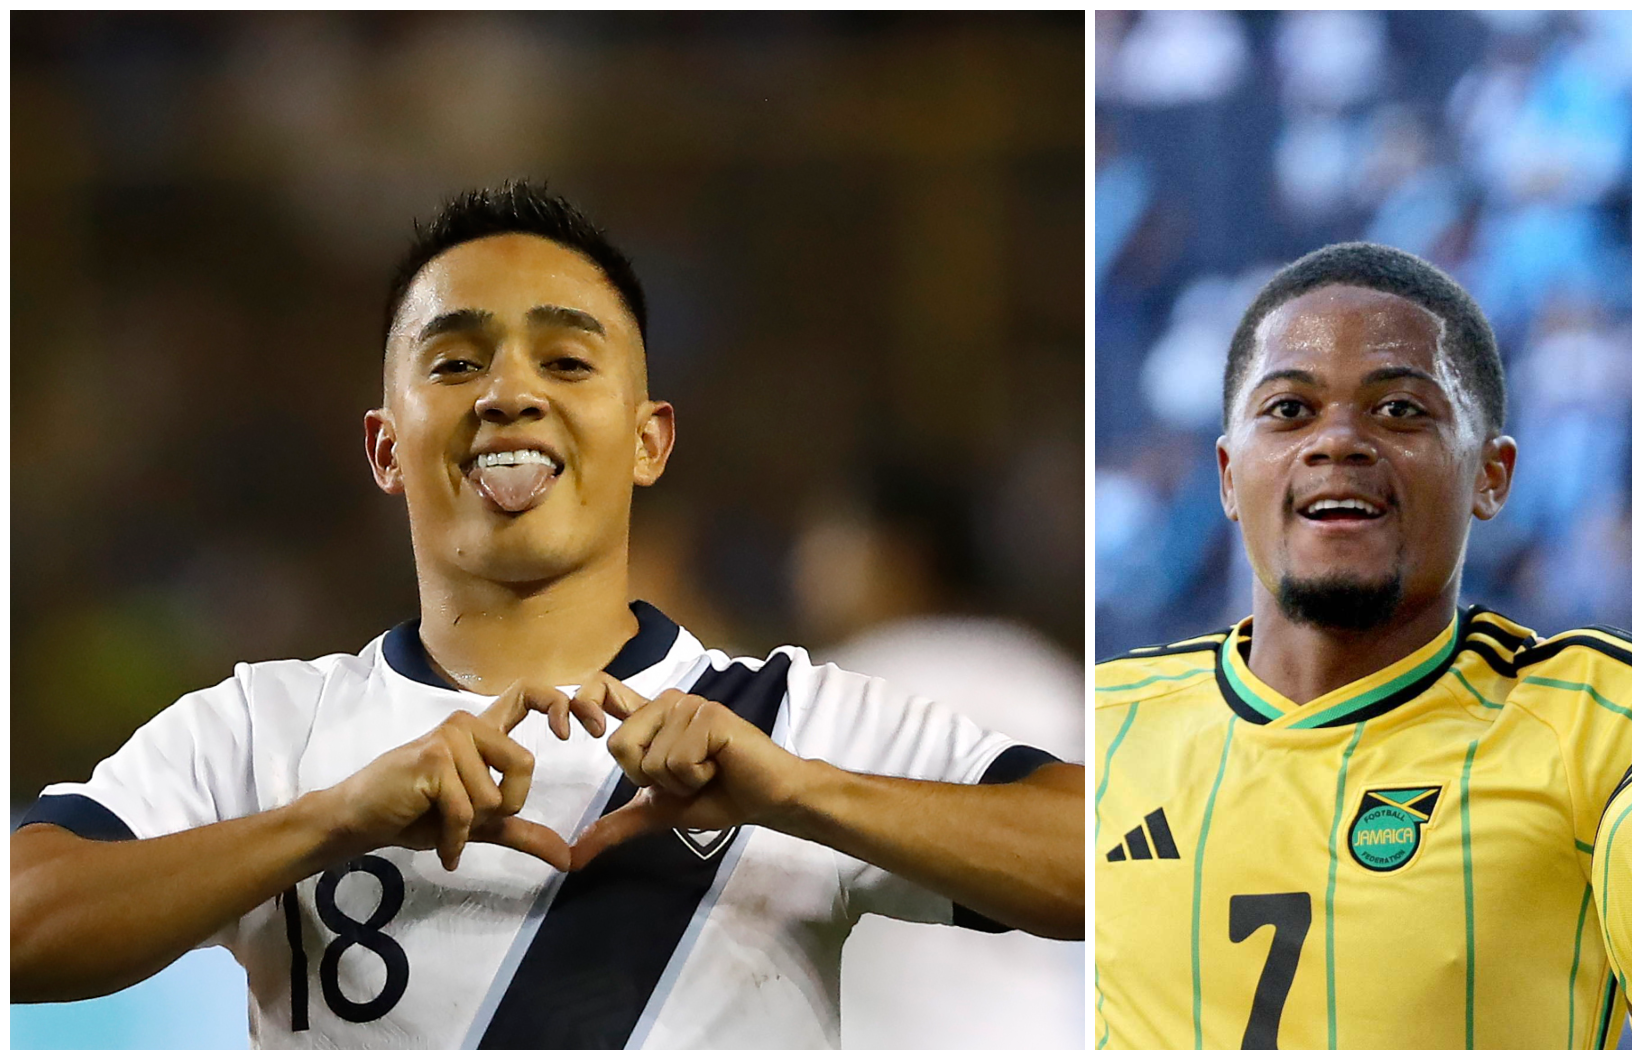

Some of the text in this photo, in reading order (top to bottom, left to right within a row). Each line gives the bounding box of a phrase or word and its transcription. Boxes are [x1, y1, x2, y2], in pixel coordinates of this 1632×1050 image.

[1363, 809, 1406, 824] FOOTBALL
[1353, 827, 1414, 847] JAMAICA
[1361, 848, 1406, 864] FEDERATION
[275, 855, 409, 1032] 18
